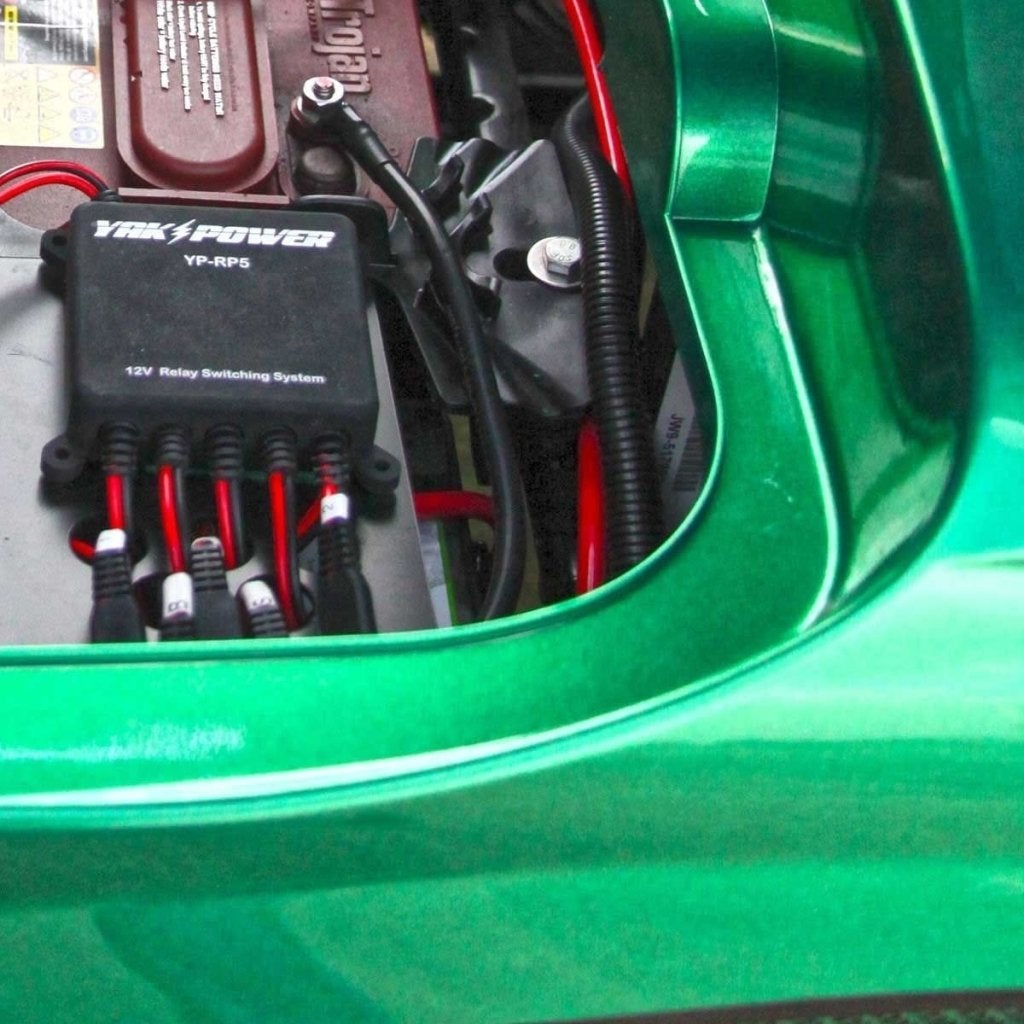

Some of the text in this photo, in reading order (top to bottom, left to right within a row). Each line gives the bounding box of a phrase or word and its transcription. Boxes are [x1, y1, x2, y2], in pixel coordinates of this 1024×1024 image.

[188, 224, 337, 249] POWER
[183, 254, 251, 269] YP-RP5
[125, 366, 326, 384] 12V Relay Switching System
